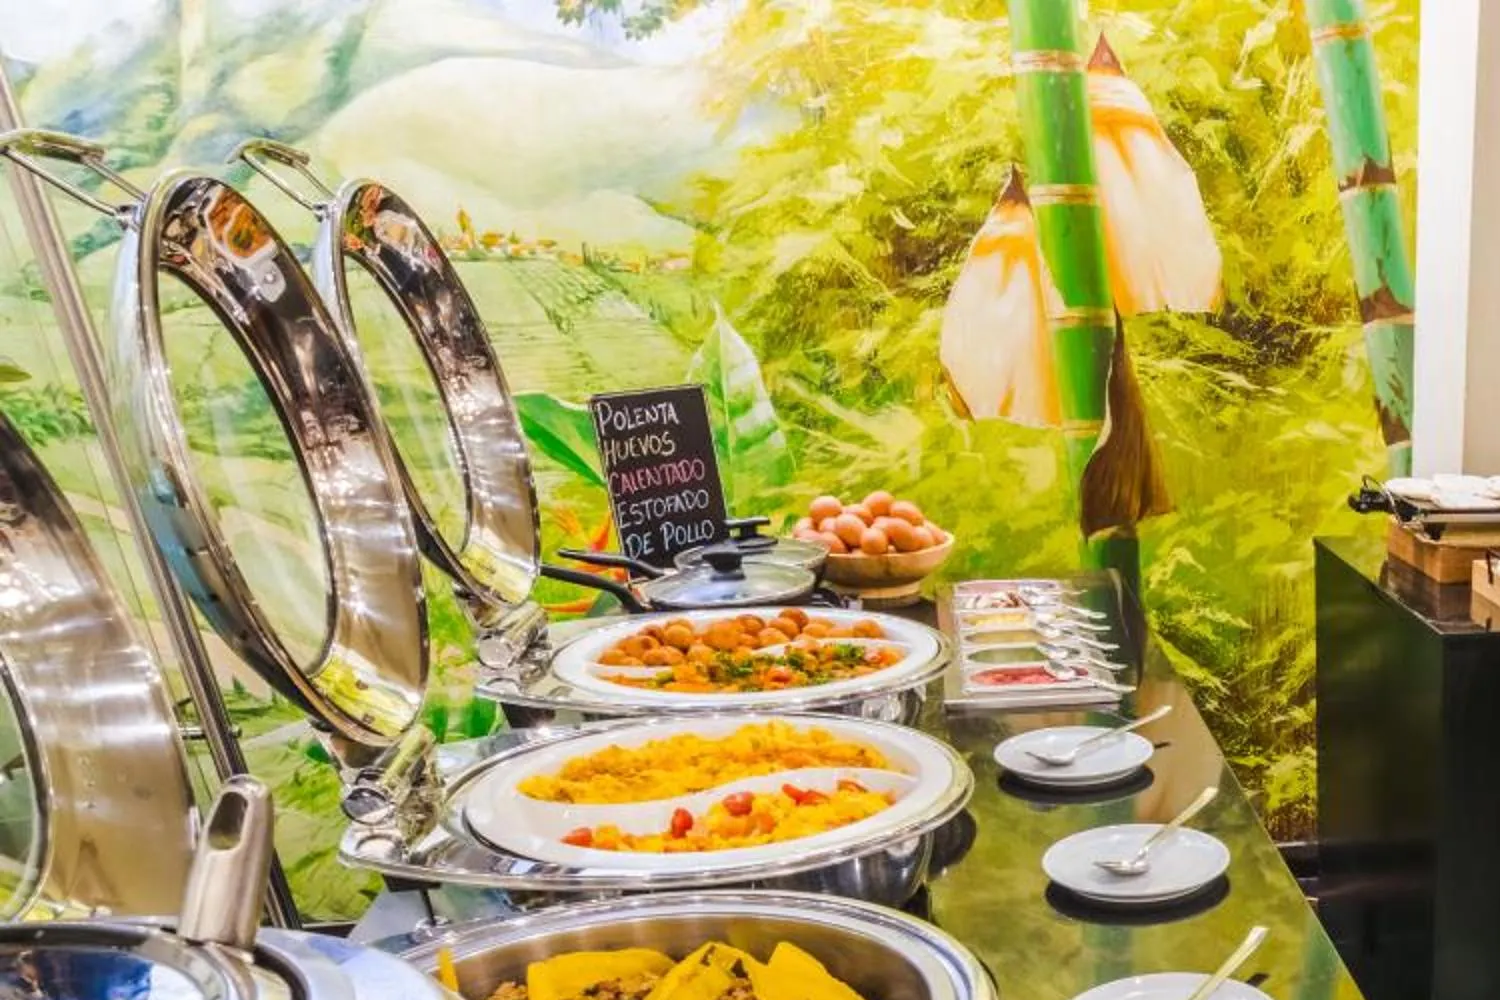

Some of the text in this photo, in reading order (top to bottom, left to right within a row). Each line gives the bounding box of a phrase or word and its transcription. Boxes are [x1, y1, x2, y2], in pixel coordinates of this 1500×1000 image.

[595, 400, 680, 436] POLENTA
[603, 431, 676, 466] HUEVOS
[609, 458, 705, 497] CALENTADO
[618, 488, 709, 529] ESTOFADO
[625, 519, 715, 560] DE POLLO
